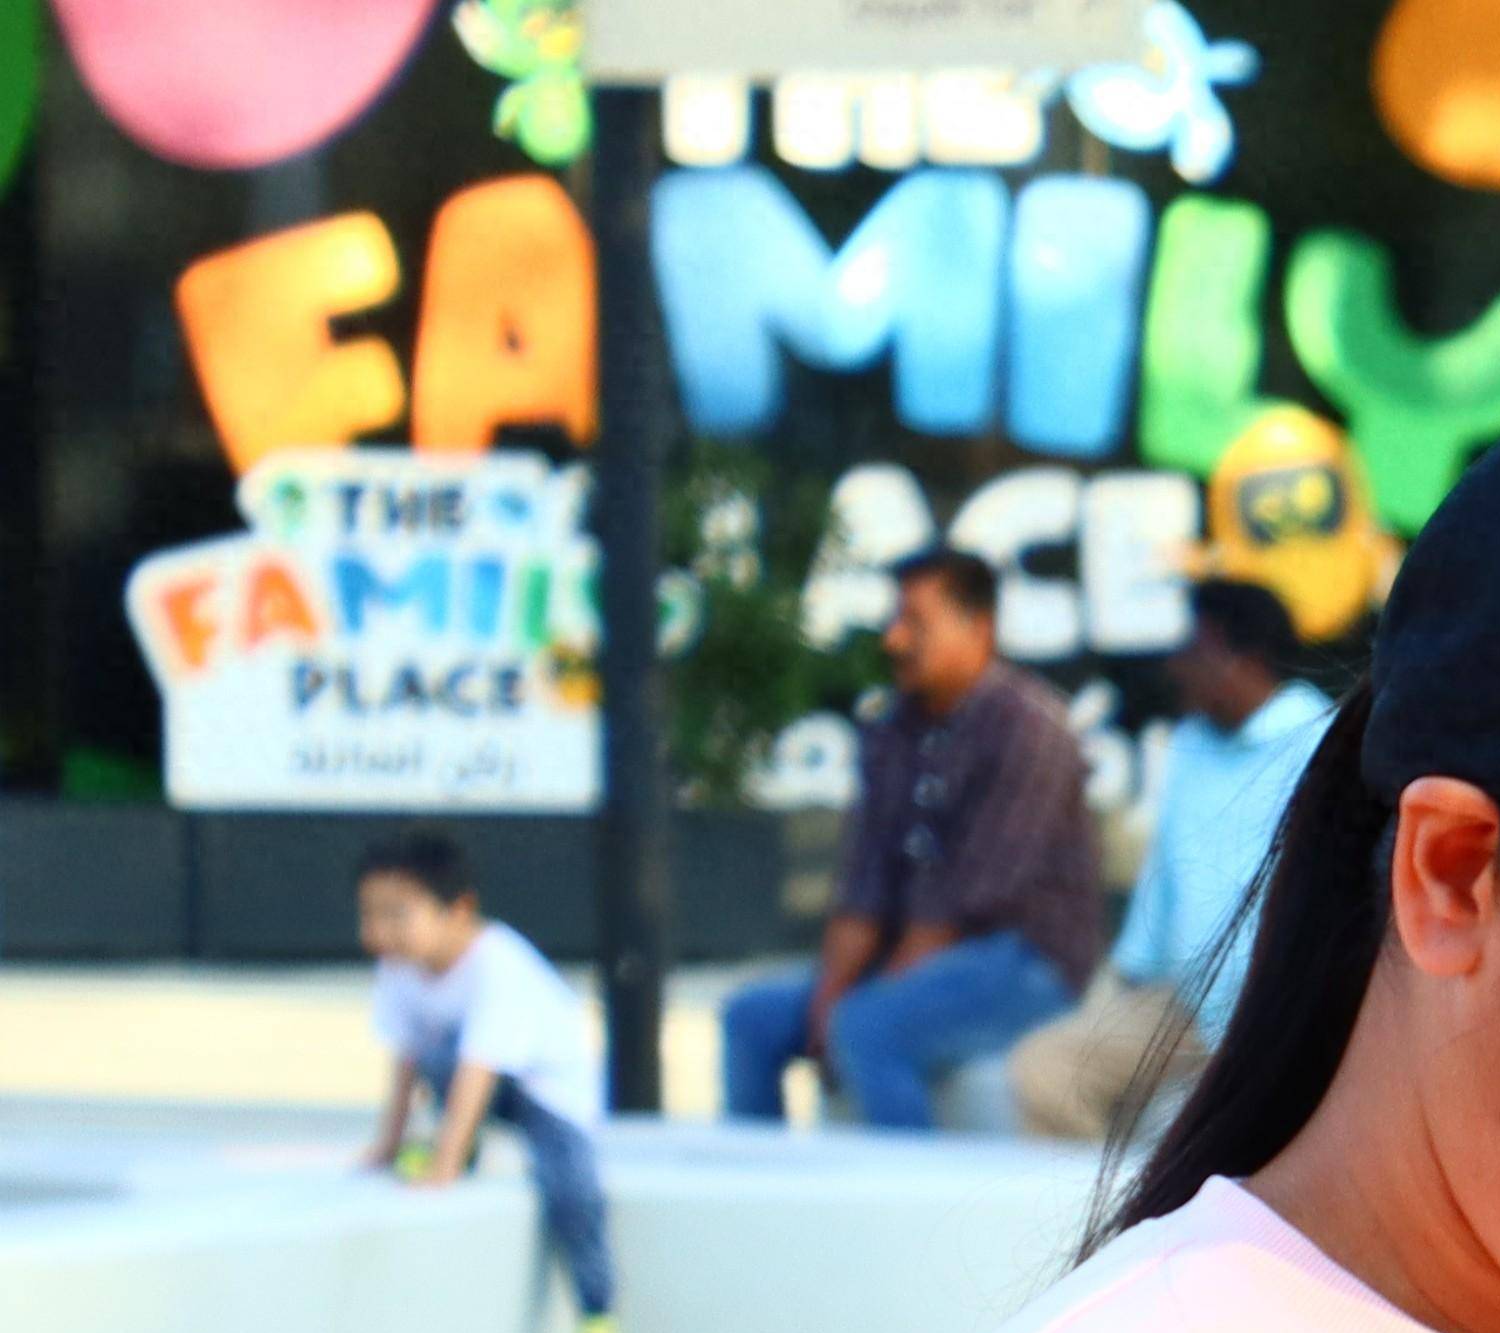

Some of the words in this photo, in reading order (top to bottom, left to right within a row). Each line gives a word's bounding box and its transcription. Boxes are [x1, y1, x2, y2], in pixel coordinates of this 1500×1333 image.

[333, 480, 467, 535] THE
[154, 550, 604, 674] FAMIL
[290, 655, 526, 718] PLACE
